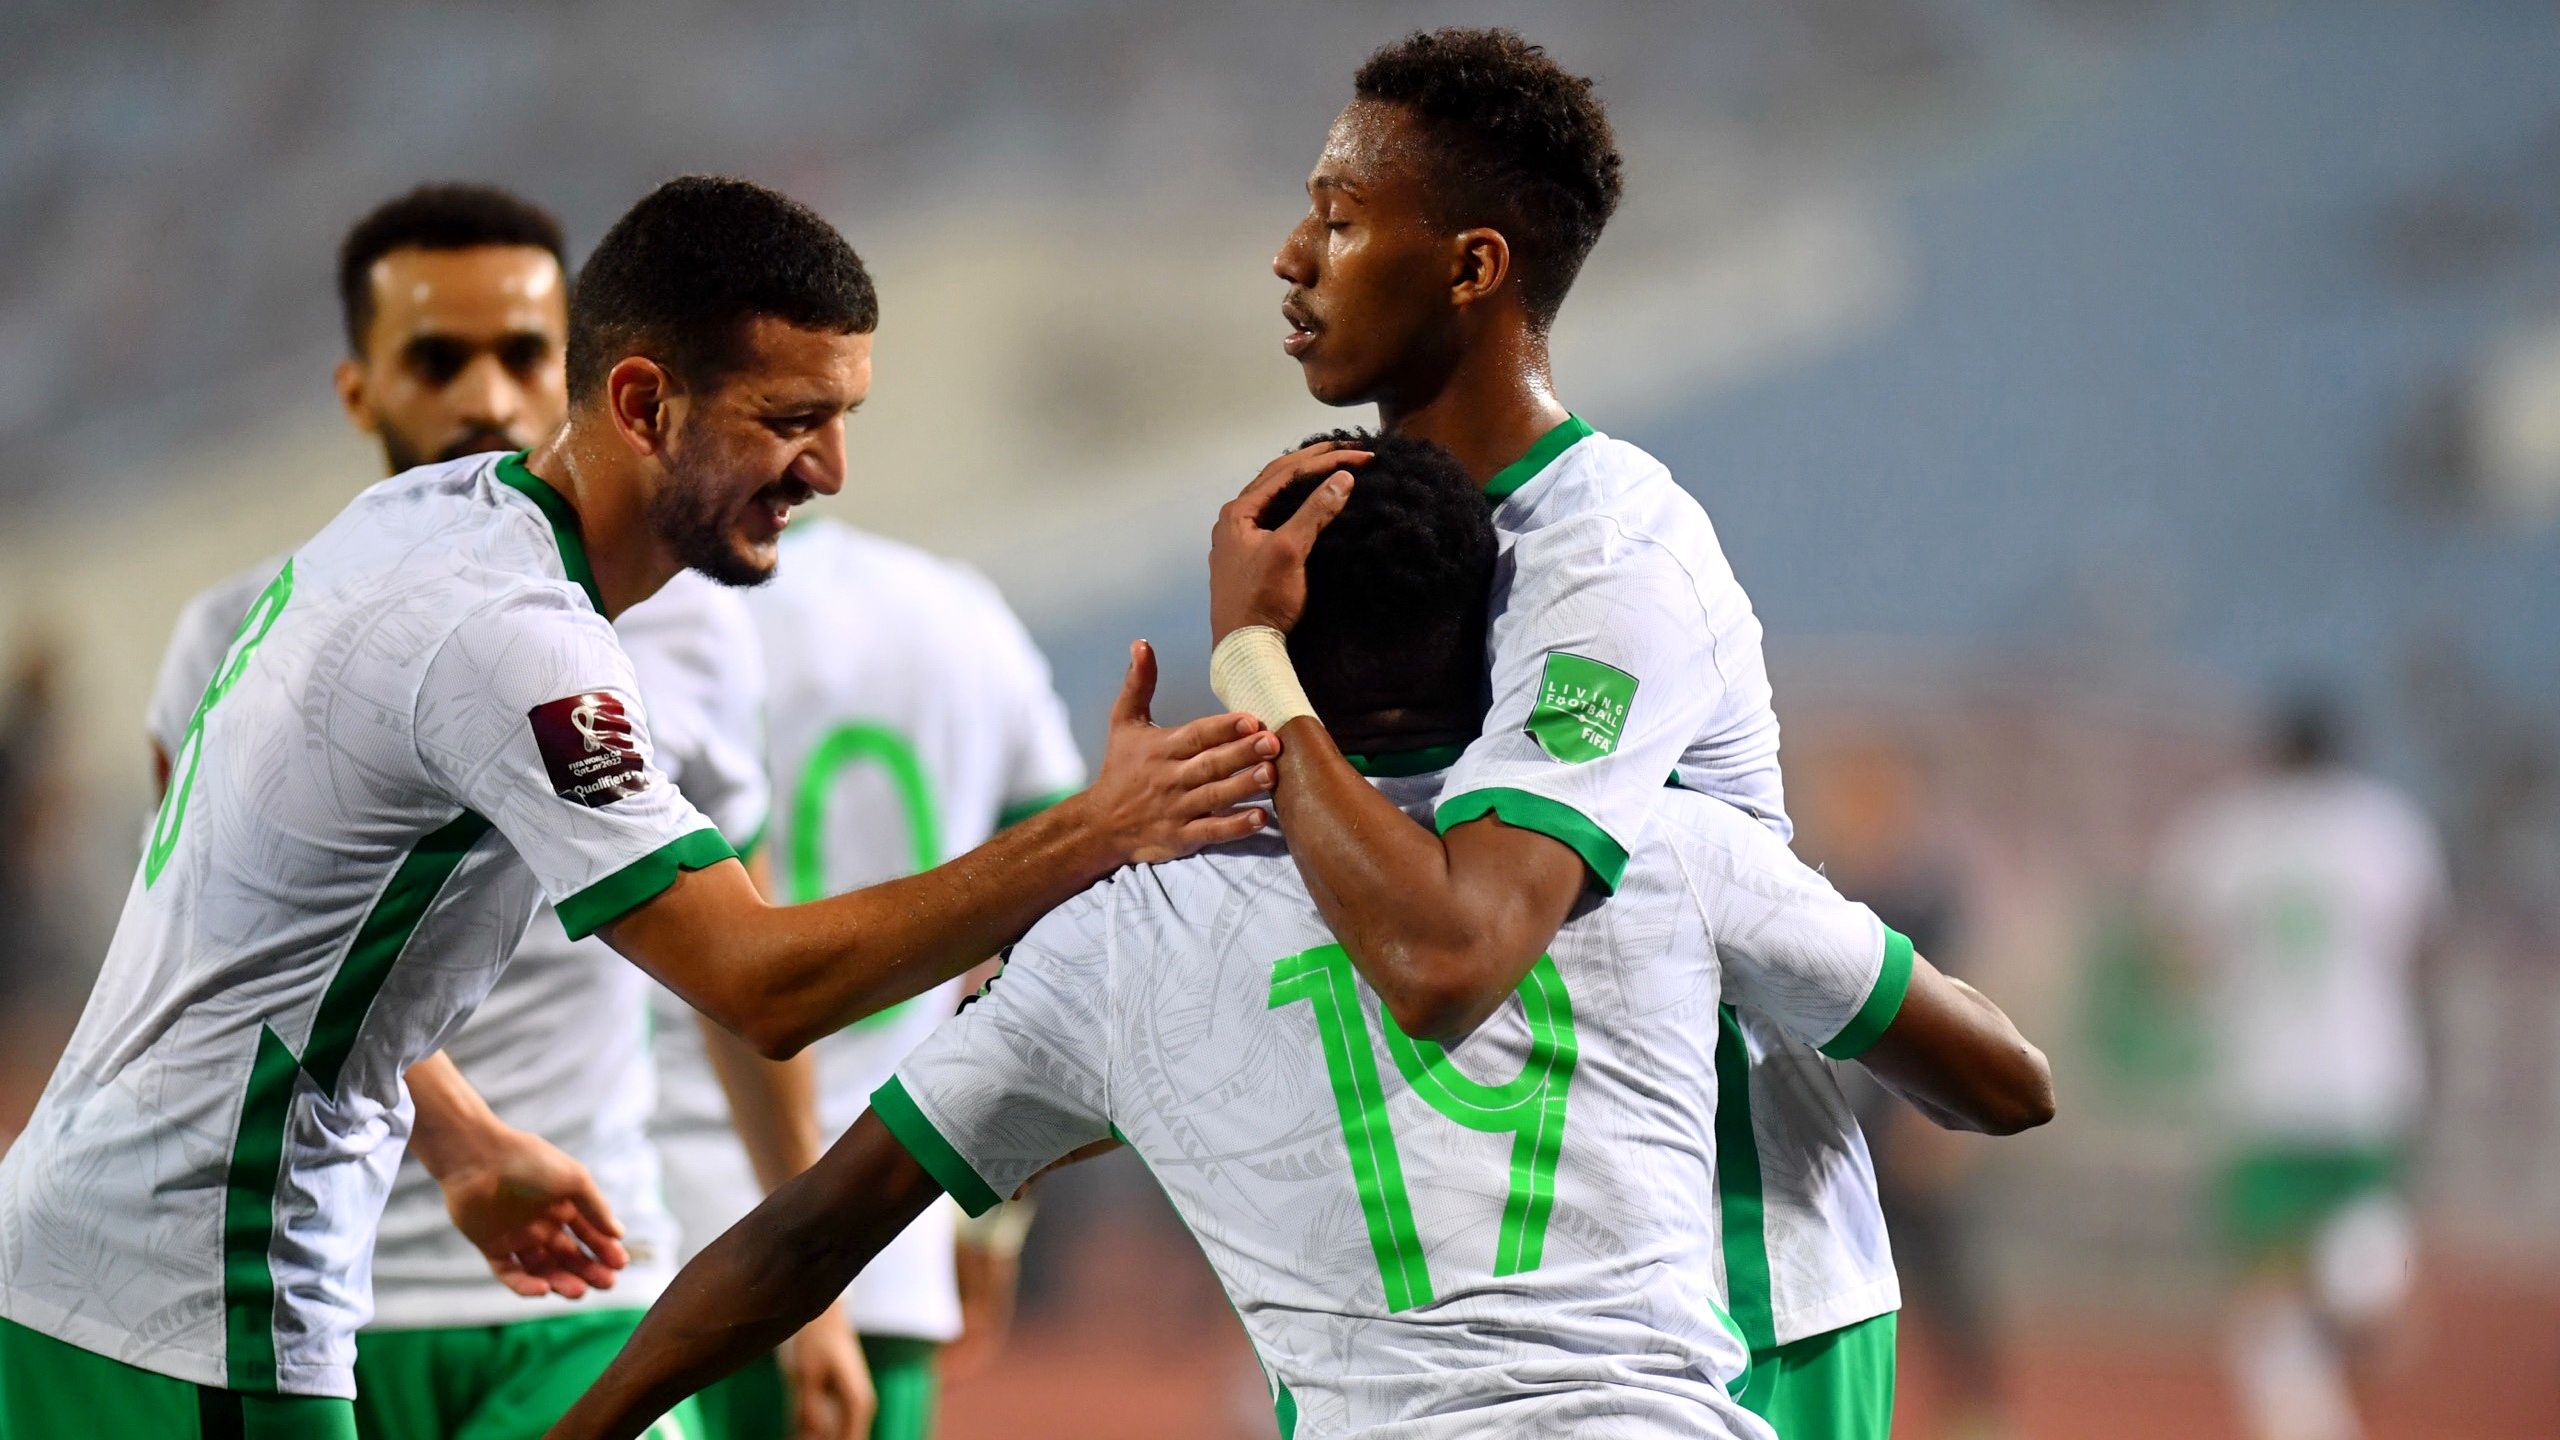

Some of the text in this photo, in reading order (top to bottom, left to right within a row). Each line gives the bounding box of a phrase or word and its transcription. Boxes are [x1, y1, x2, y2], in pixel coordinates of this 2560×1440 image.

[1545, 693, 1617, 728] FOOTBALL
[1548, 681, 1623, 716] LIVING
[1581, 727, 1611, 753] FIFA
[583, 753, 610, 765] WORLD
[574, 771, 632, 797] Qualifiers
[1267, 942, 1578, 1314] 19
